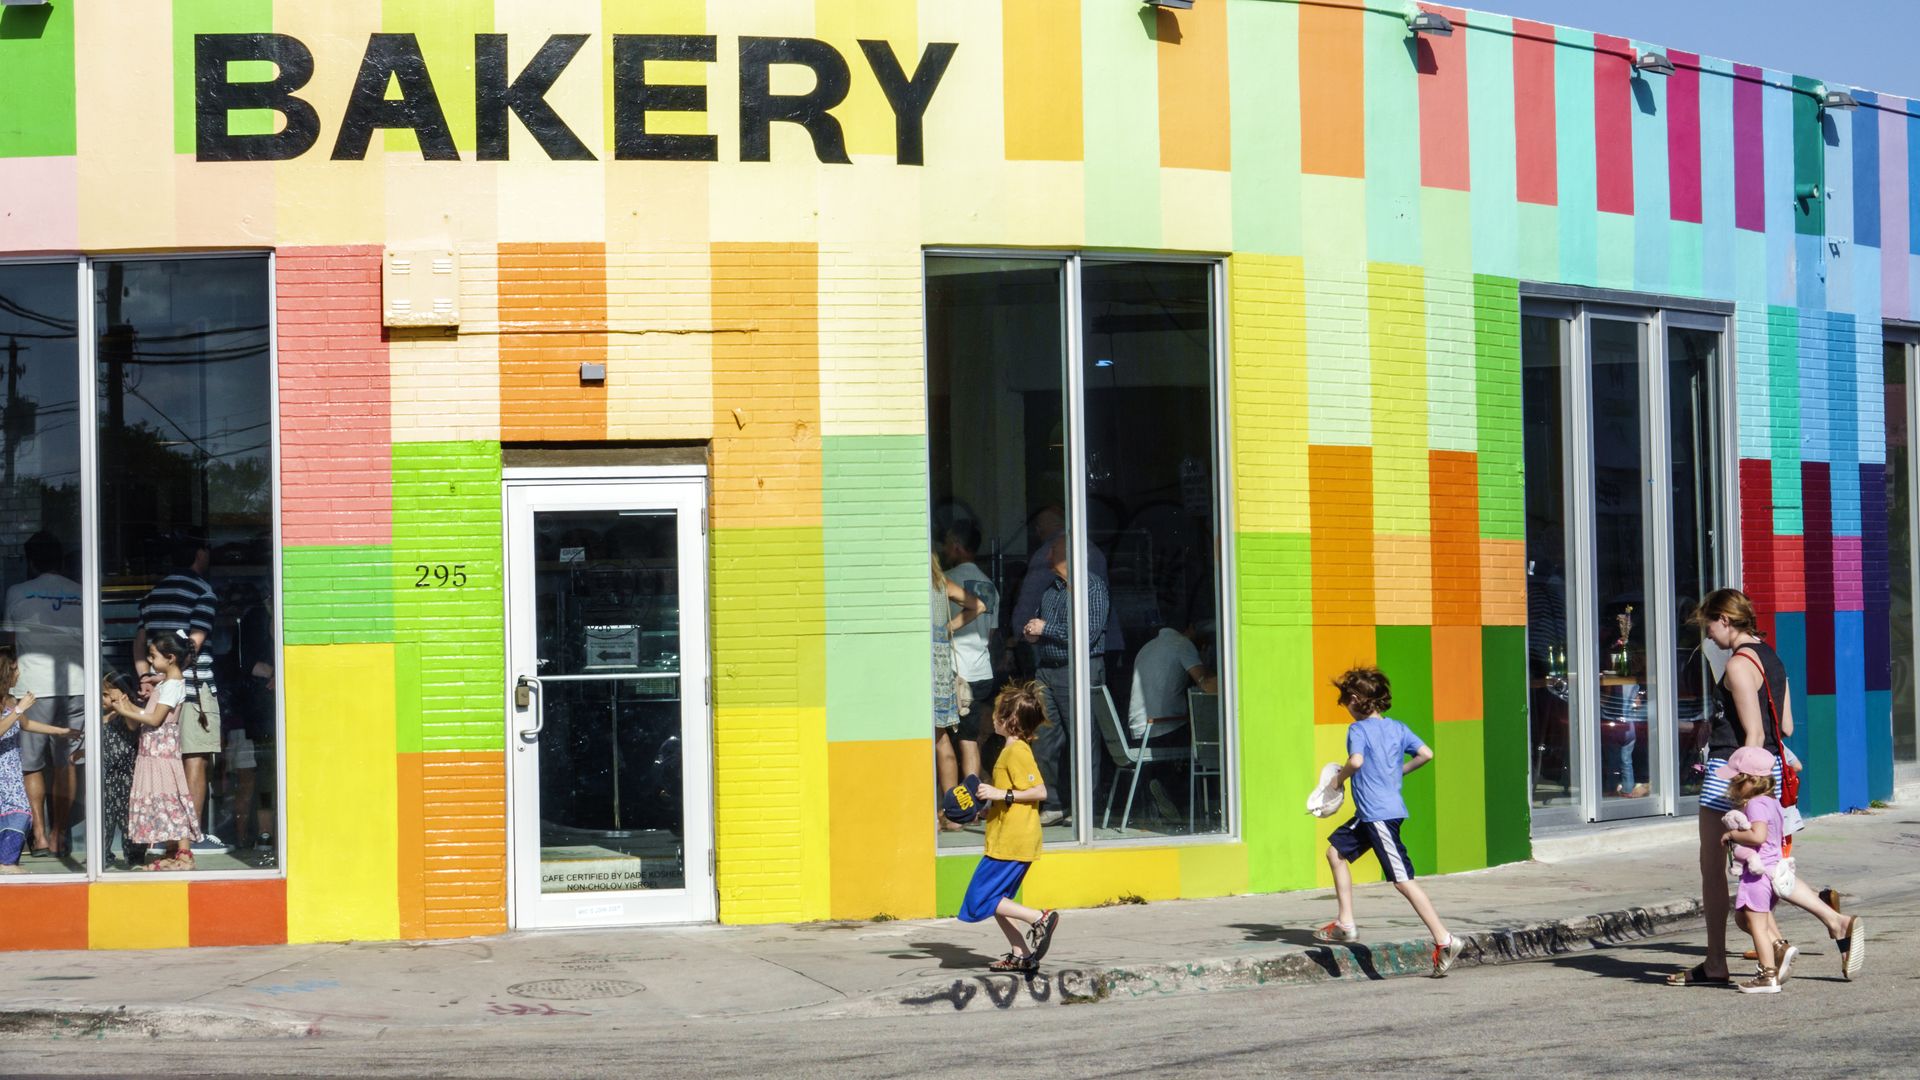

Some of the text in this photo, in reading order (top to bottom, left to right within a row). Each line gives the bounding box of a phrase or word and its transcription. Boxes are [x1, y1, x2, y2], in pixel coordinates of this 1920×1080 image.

[194, 33, 959, 166] BAKERY
[415, 565, 467, 587] 295
[542, 874, 564, 882] CAFE
[566, 873, 610, 881] CERTIFIED
[611, 872, 622, 880] BY
[624, 871, 648, 880] DADE
